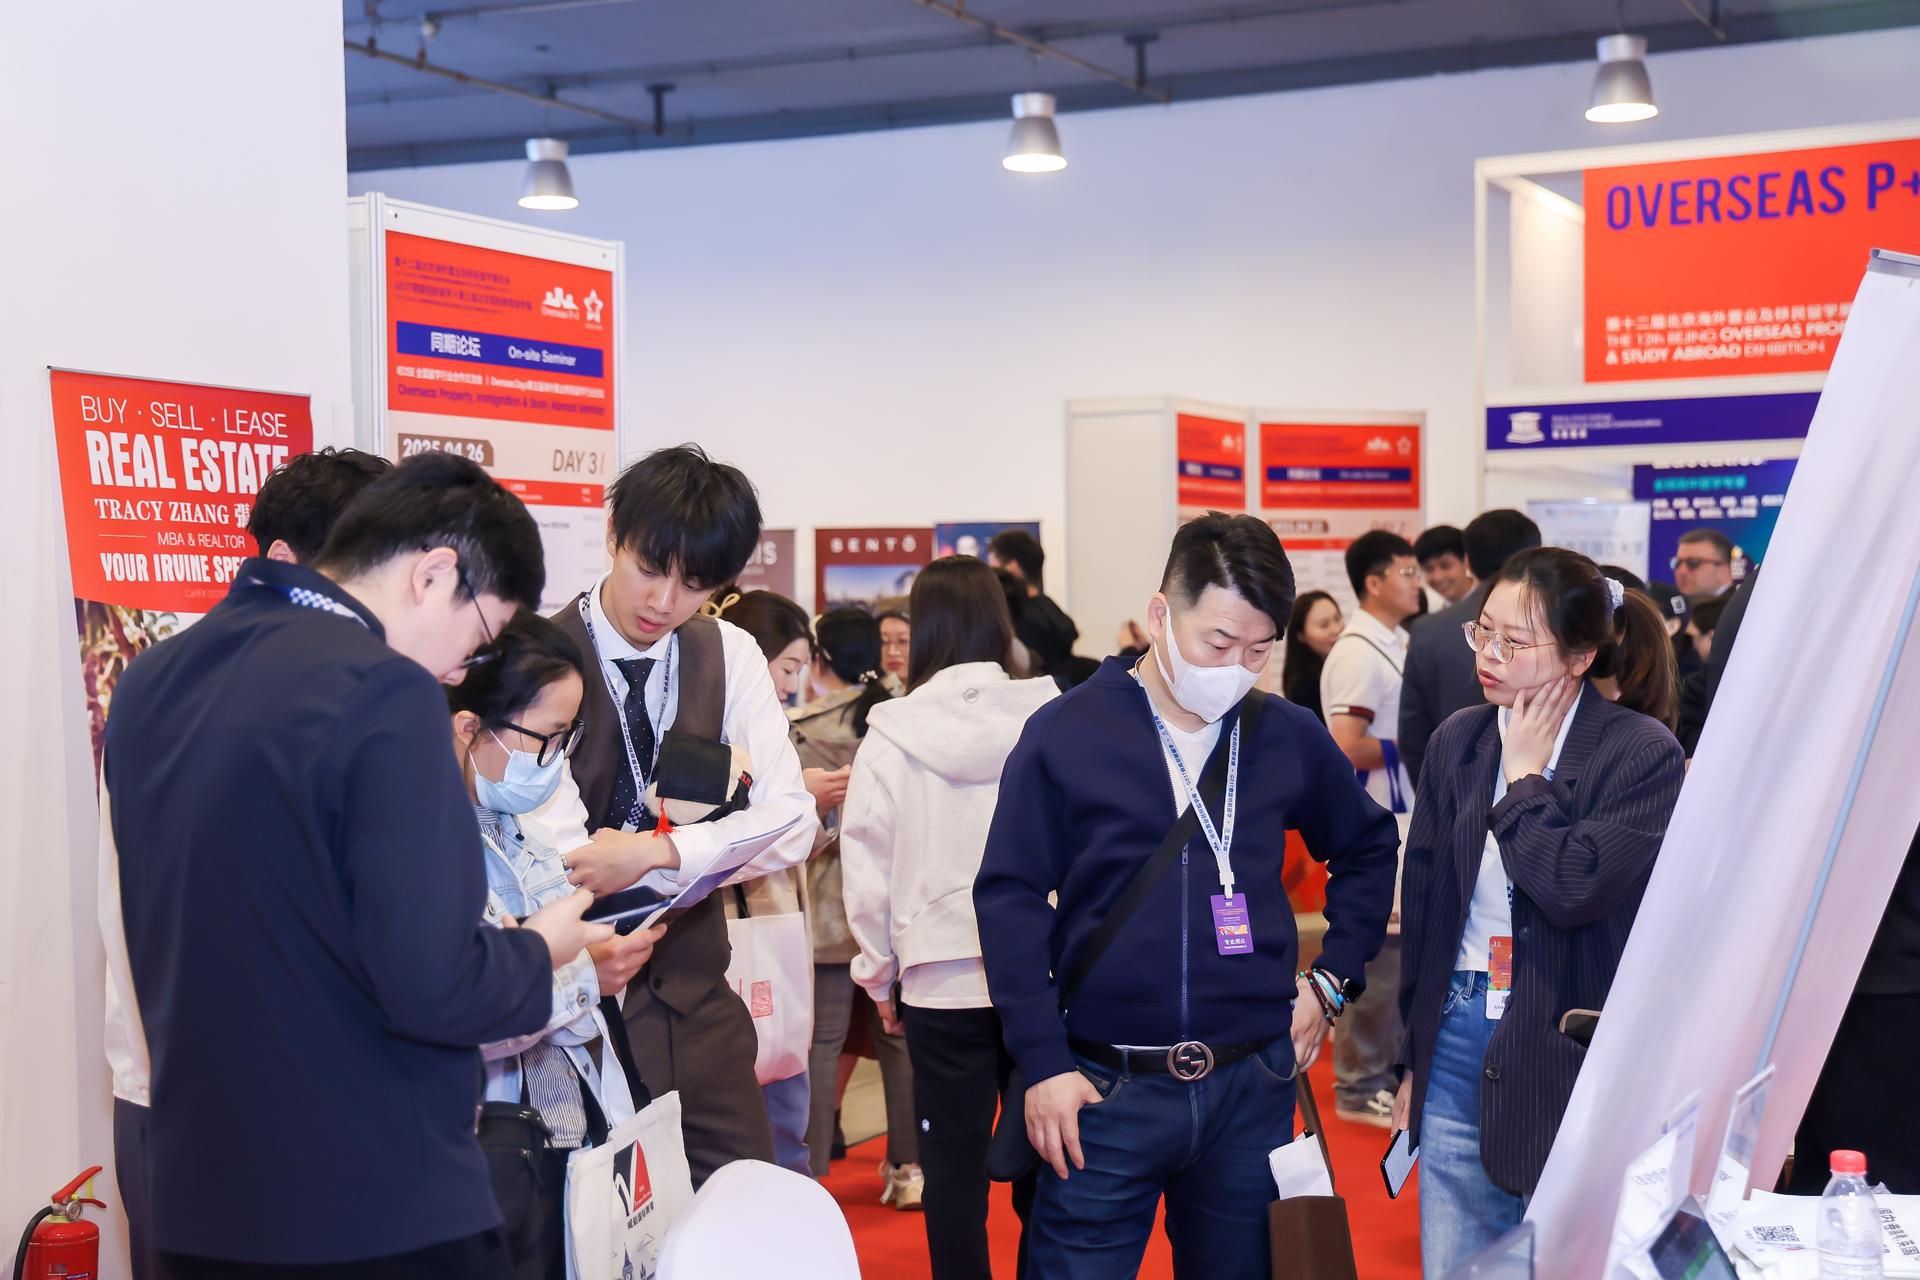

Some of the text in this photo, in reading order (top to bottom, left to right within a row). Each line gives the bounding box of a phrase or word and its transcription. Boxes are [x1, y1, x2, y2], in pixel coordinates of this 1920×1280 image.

[1607, 165, 1846, 230] OVERSEAS
[430, 331, 481, 358] 同期论坛
[1607, 332, 1631, 347] THE
[1667, 328, 1718, 345] BEIJING
[1719, 322, 1803, 343] OVERSEAS
[508, 345, 577, 366] On-site Seminar
[1621, 347, 1669, 364] STUDY
[1672, 343, 1741, 361] ABROAD
[1744, 339, 1825, 357] EXHIBITION
[80, 395, 288, 438] BUY SELL LEASE
[85, 430, 176, 489] REAL
[553, 449, 585, 473] DAY
[94, 498, 229, 525] TRACY ZHANG
[157, 532, 246, 549] MBA & REALTOR
[100, 552, 248, 584] YOUR IRVINE SPE
